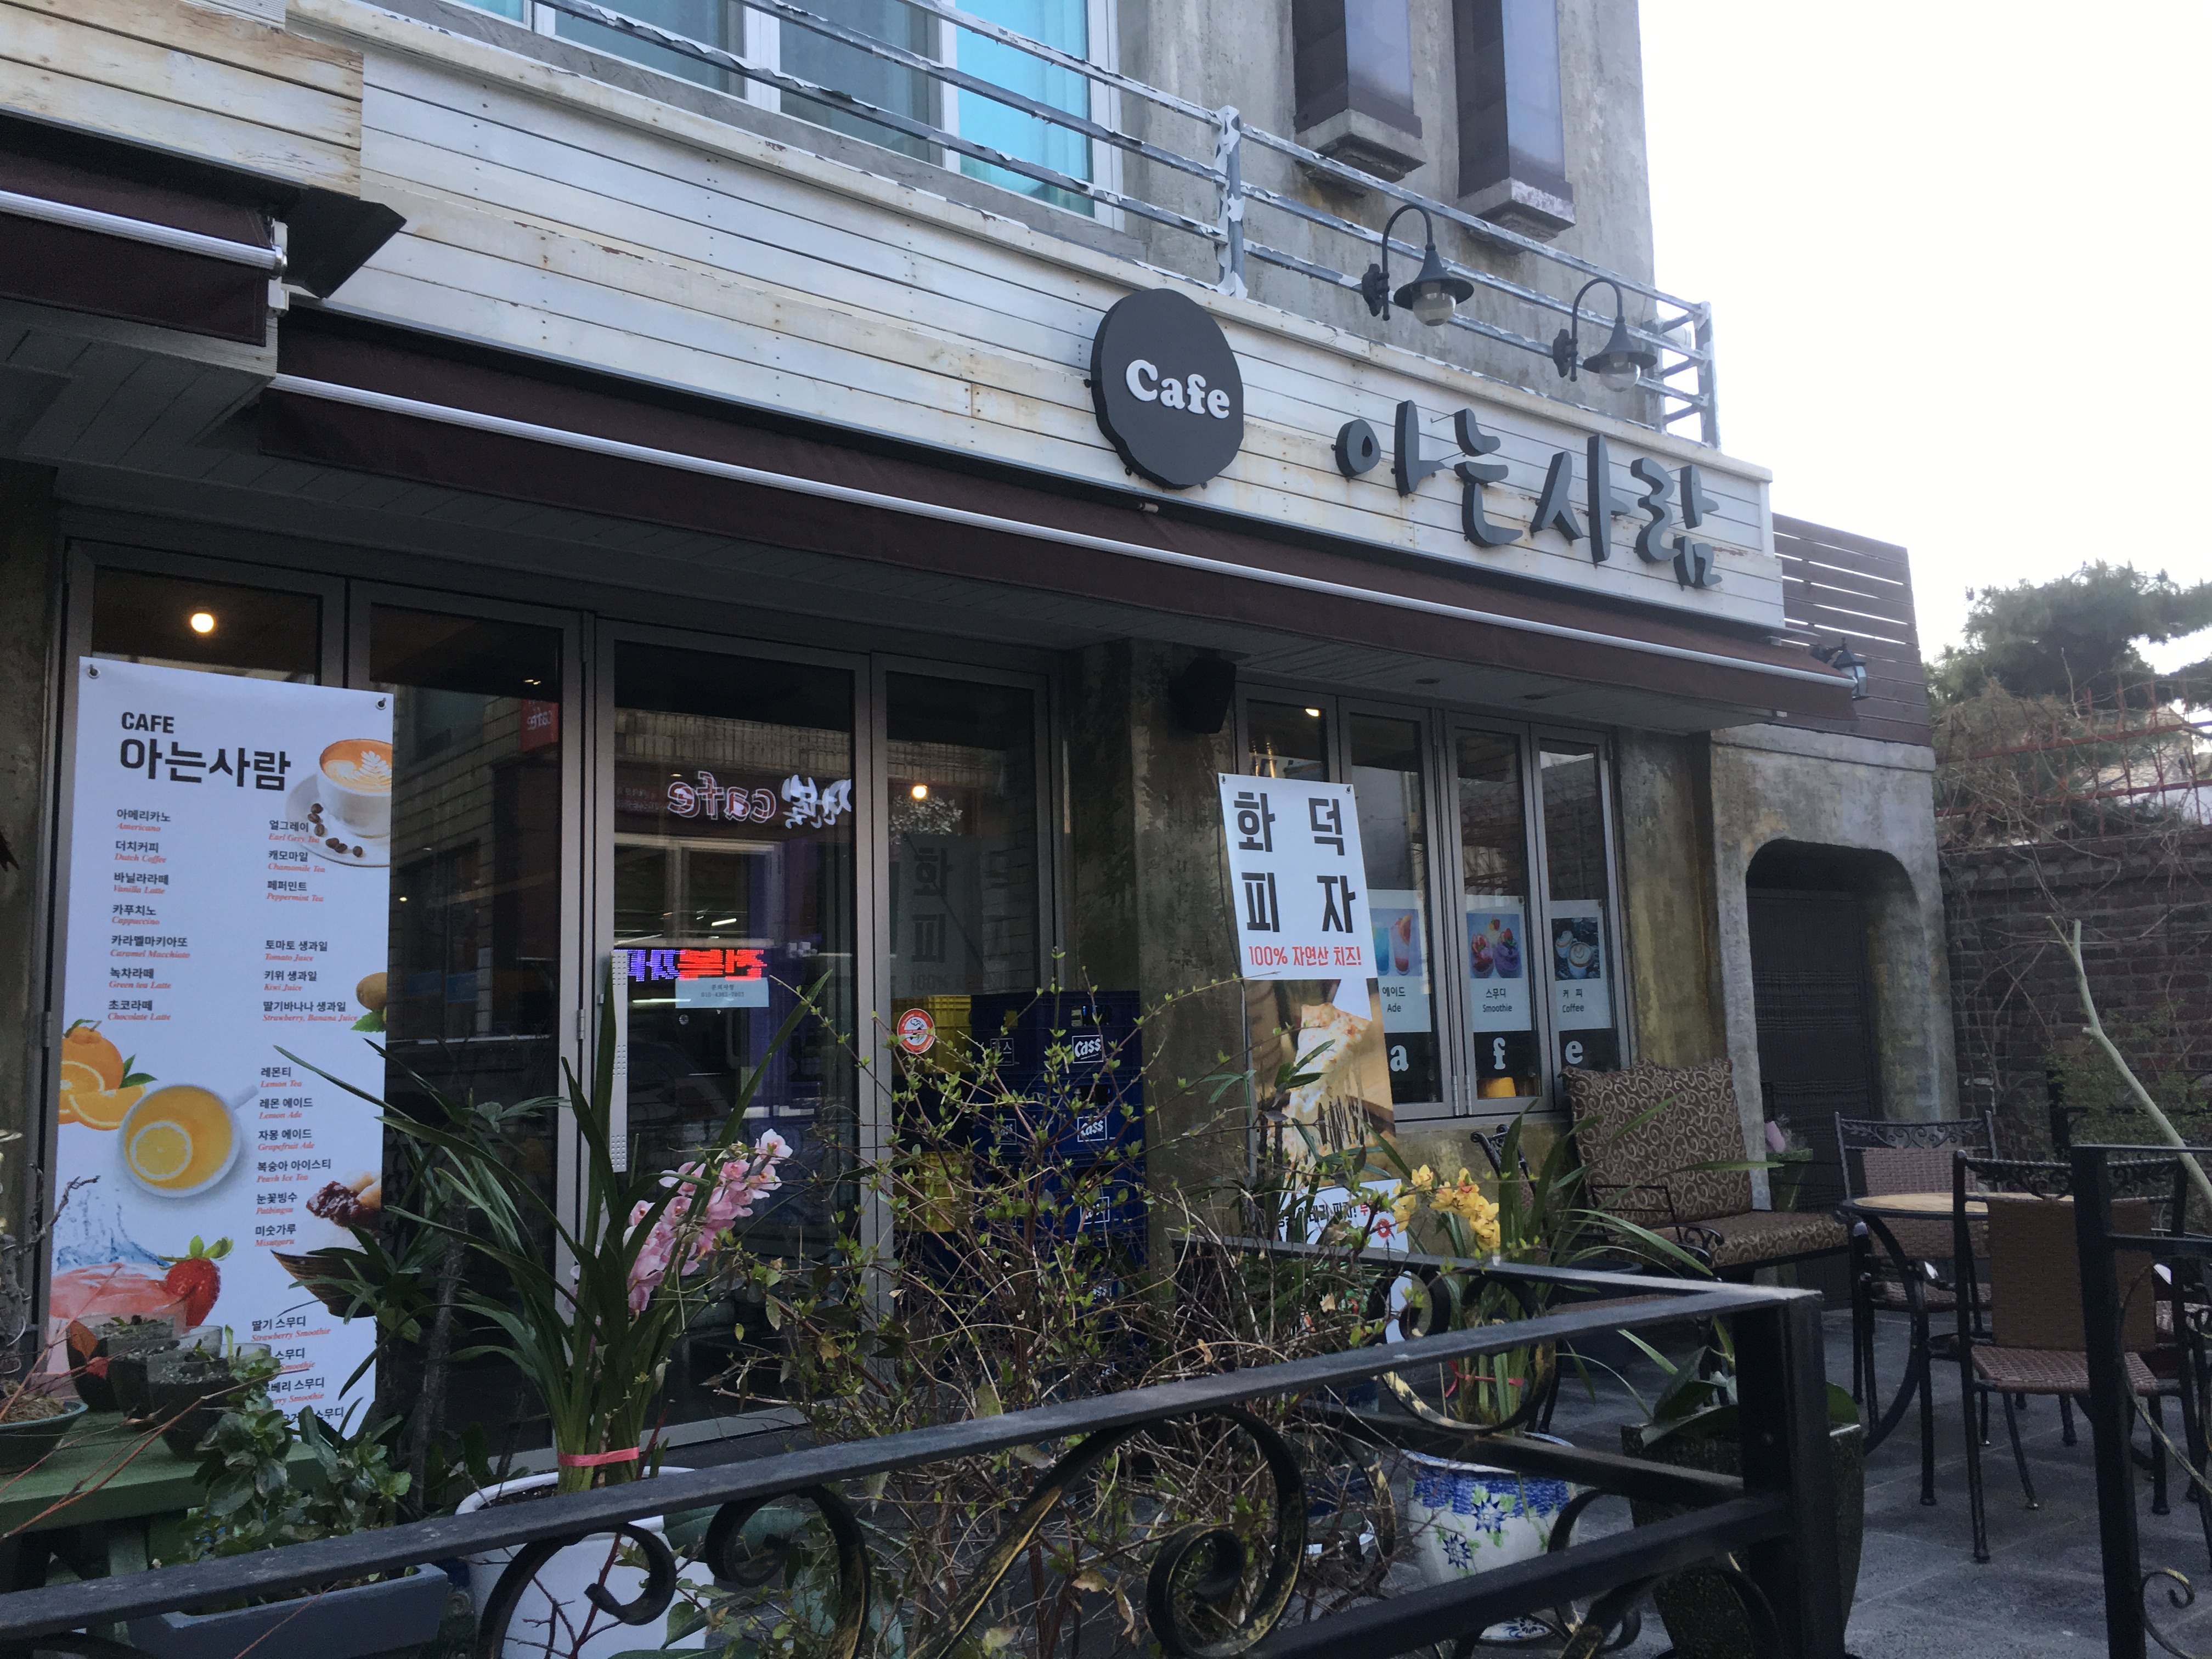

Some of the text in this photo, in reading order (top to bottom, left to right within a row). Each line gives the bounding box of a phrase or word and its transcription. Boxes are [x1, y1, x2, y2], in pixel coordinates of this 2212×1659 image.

[1126, 359, 1230, 419] Cafe
[1334, 399, 1723, 589] 아는사람
[121, 712, 175, 734] CAFE
[120, 738, 291, 792] 아는사람
[117, 809, 171, 822] 아메리카노
[116, 822, 161, 832] Americano
[269, 820, 309, 832] 얼그레이
[116, 840, 159, 853] 더치커피
[115, 853, 167, 864] Dutch Coffee
[268, 850, 308, 862] 캐모마일
[268, 863, 311, 872] Chamomile
[114, 872, 169, 885] 바닐라라떼
[114, 884, 165, 894] Vanilla Latte
[267, 880, 307, 891] 페퍼민트
[267, 893, 309, 901] Peppermint
[112, 904, 156, 916] 카푸치노
[111, 916, 160, 926] Cappuccino
[111, 934, 188, 947] 카라멜마키아또
[265, 940, 328, 952] 토마토 생과일
[110, 949, 190, 958] Caramel Macchiato
[1249, 945, 1362, 966] 100% 자연산 치즈!
[110, 967, 154, 979] 녹차라떼
[264, 970, 317, 981] 키위 생과일
[109, 980, 134, 989] Green
[1382, 986, 1406, 997] 에이드
[1486, 988, 1506, 999] 스무디
[109, 1000, 153, 1011] 초코라떼
[263, 1001, 346, 1012] 딸기바나나 생과일
[1387, 1003, 1402, 1012] Ade
[1482, 1004, 1513, 1013] Smoothie
[1562, 1003, 1584, 1013] Coffee
[1074, 1038, 1102, 1057] Cass
[261, 1066, 291, 1078] 레몬티
[259, 1097, 313, 1109] 레몬 에이드
[258, 1128, 312, 1141] 자몽 에이드
[258, 1143, 298, 1152] Grapefruit
[257, 1158, 331, 1172] 복숭아 아이스티
[256, 1192, 298, 1205] 눈꽃빙수
[255, 1223, 297, 1237] 미숫가루
[252, 1315, 306, 1331] 딸기 스무디
[251, 1328, 331, 1342] Strawberry Smoothie
[275, 1347, 306, 1361] 스무디
[294, 1377, 325, 1391] 스무디
[289, 1392, 324, 1403] Smoothie
